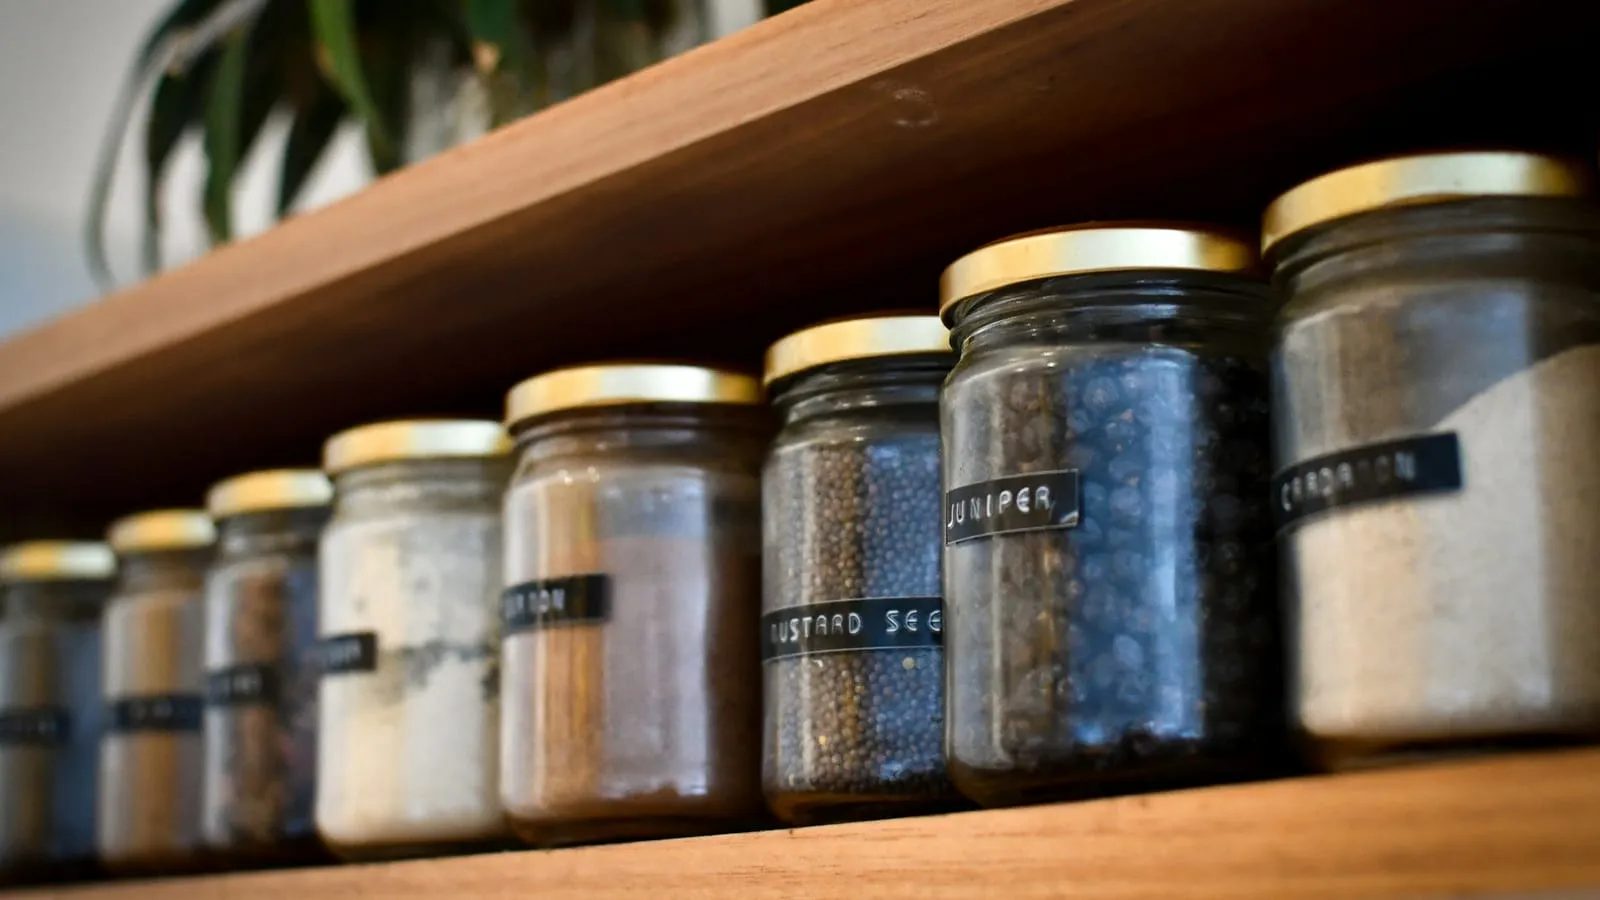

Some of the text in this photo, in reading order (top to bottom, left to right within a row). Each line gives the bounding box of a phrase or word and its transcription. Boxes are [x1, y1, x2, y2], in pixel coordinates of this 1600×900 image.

[1281, 451, 1417, 512] CARDAON
[947, 486, 1050, 529] JUNIPER
[770, 612, 863, 644] USTARD
